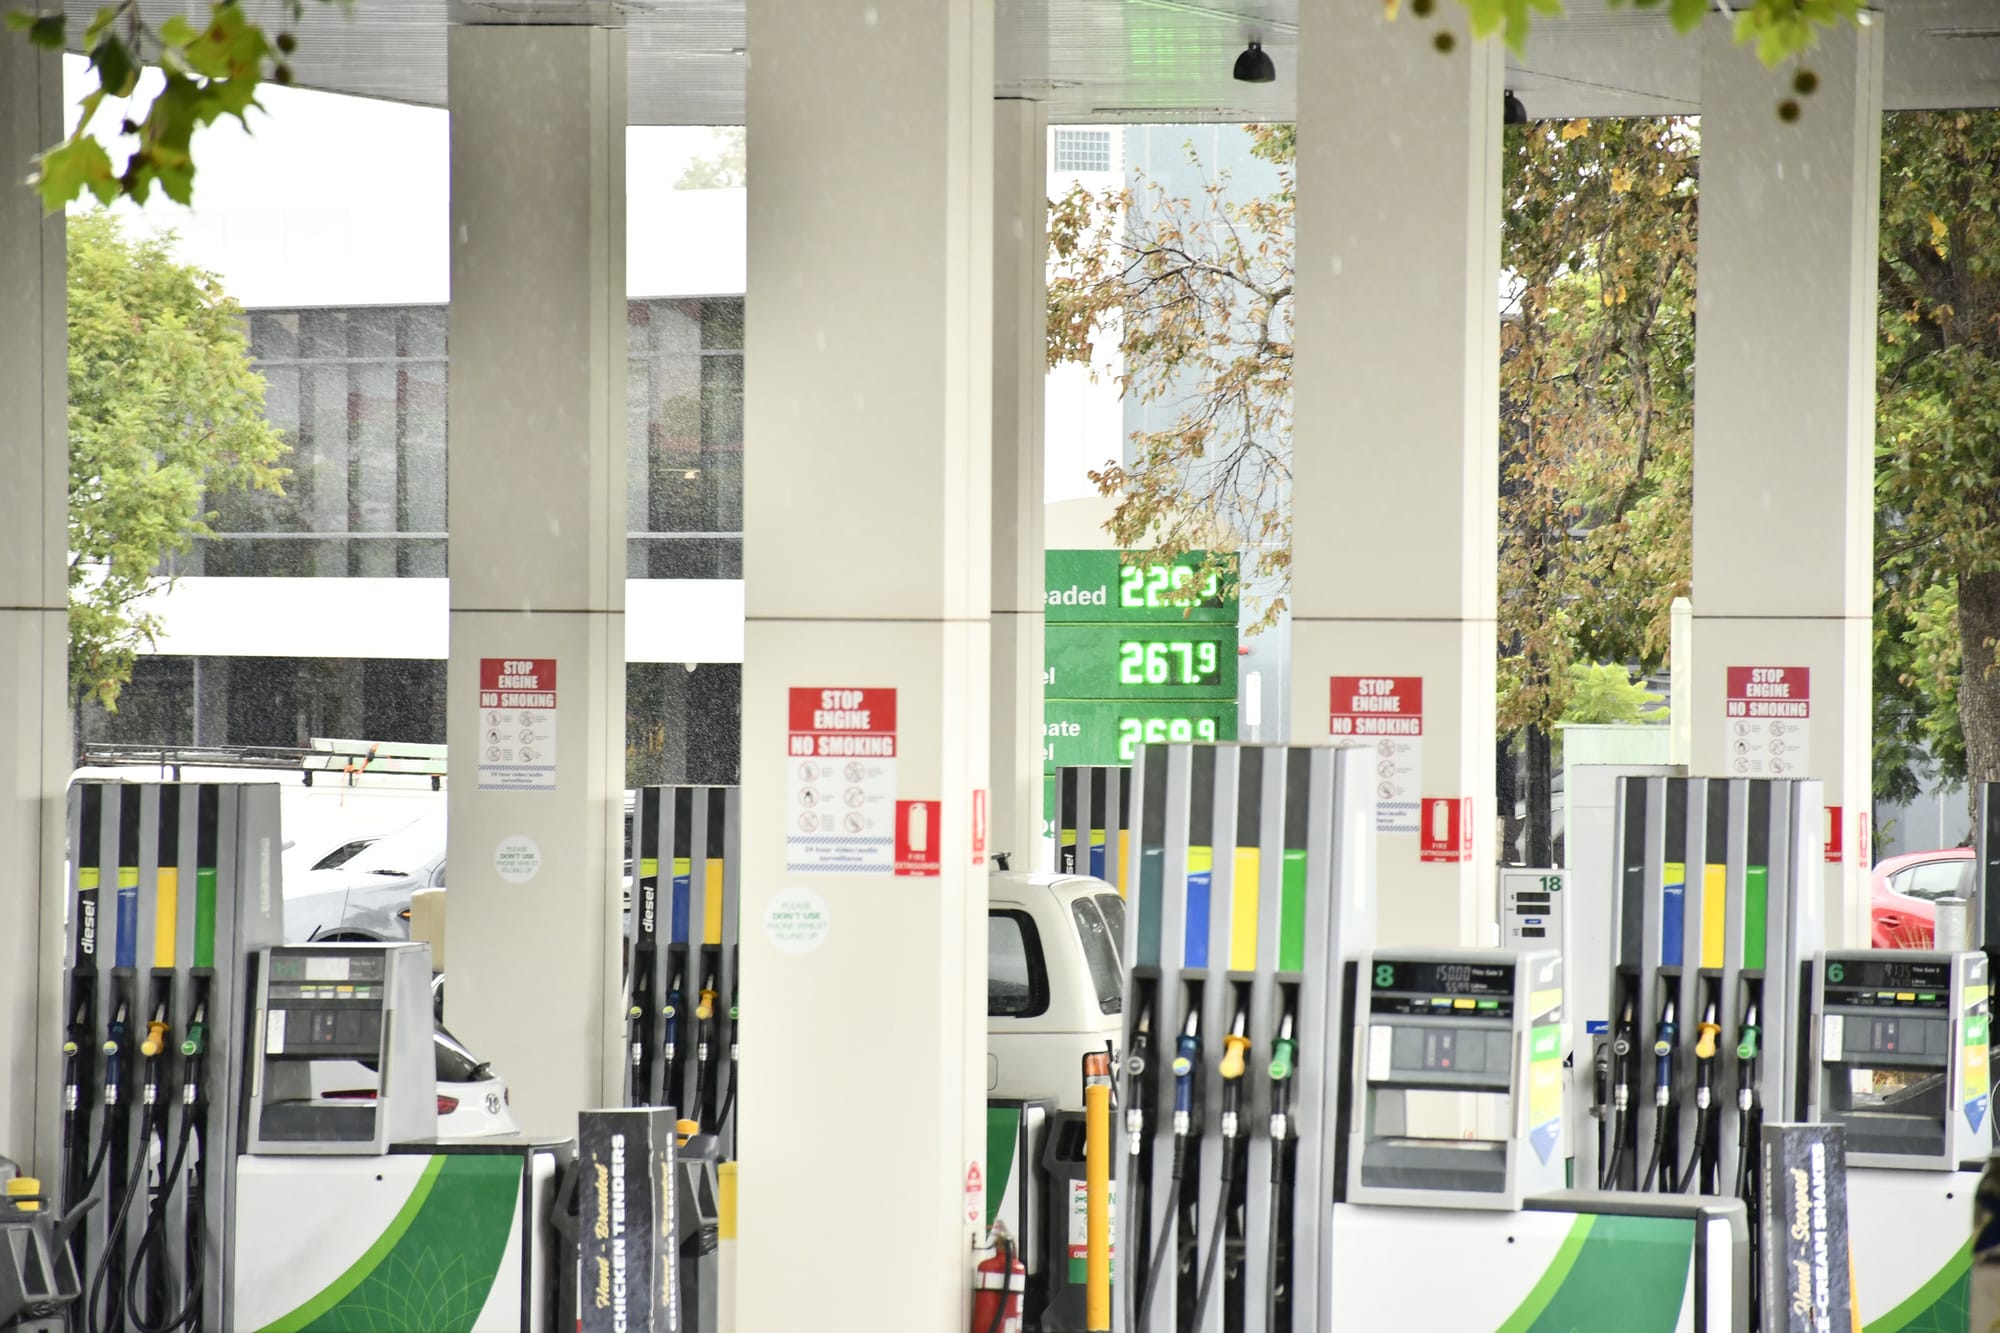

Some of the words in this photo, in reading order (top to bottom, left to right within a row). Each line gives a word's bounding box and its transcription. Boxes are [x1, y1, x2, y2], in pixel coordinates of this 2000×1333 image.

[504, 661, 533, 675] STOP
[1120, 642, 1216, 684] 267.9
[498, 675, 538, 689] ENGINE
[1752, 669, 1784, 683] STOP
[1358, 679, 1394, 696] STOP
[1746, 683, 1790, 698] ENGINE
[482, 693, 498, 707] NO
[501, 693, 554, 708] SMOKING
[821, 690, 864, 710] STOP
[1352, 696, 1401, 712] ENGINE
[1728, 702, 1746, 716] NO
[1750, 702, 1807, 717] SMOKING
[814, 710, 871, 730] ENGINE
[1332, 717, 1352, 734] NO
[1355, 718, 1420, 735] SMOKING
[791, 735, 814, 756] NO
[818, 736, 893, 757] SMOKING
[1539, 876, 1562, 892] 18
[642, 886, 654, 933] diesel
[80, 900, 96, 954] diesel
[1375, 965, 1394, 987] 8
[1828, 963, 1844, 982] 6
[611, 1134, 625, 1237] TENDERS
[1811, 1142, 1828, 1230] SHAKES
[594, 1162, 609, 1239] Breaded
[1790, 1167, 1813, 1243] Scooped
[595, 1255, 610, 1309] Hand
[613, 1239, 627, 1333] CHICKEN
[1792, 1259, 1812, 1316] Hand
[1814, 1231, 1831, 1333] E-CREAM
